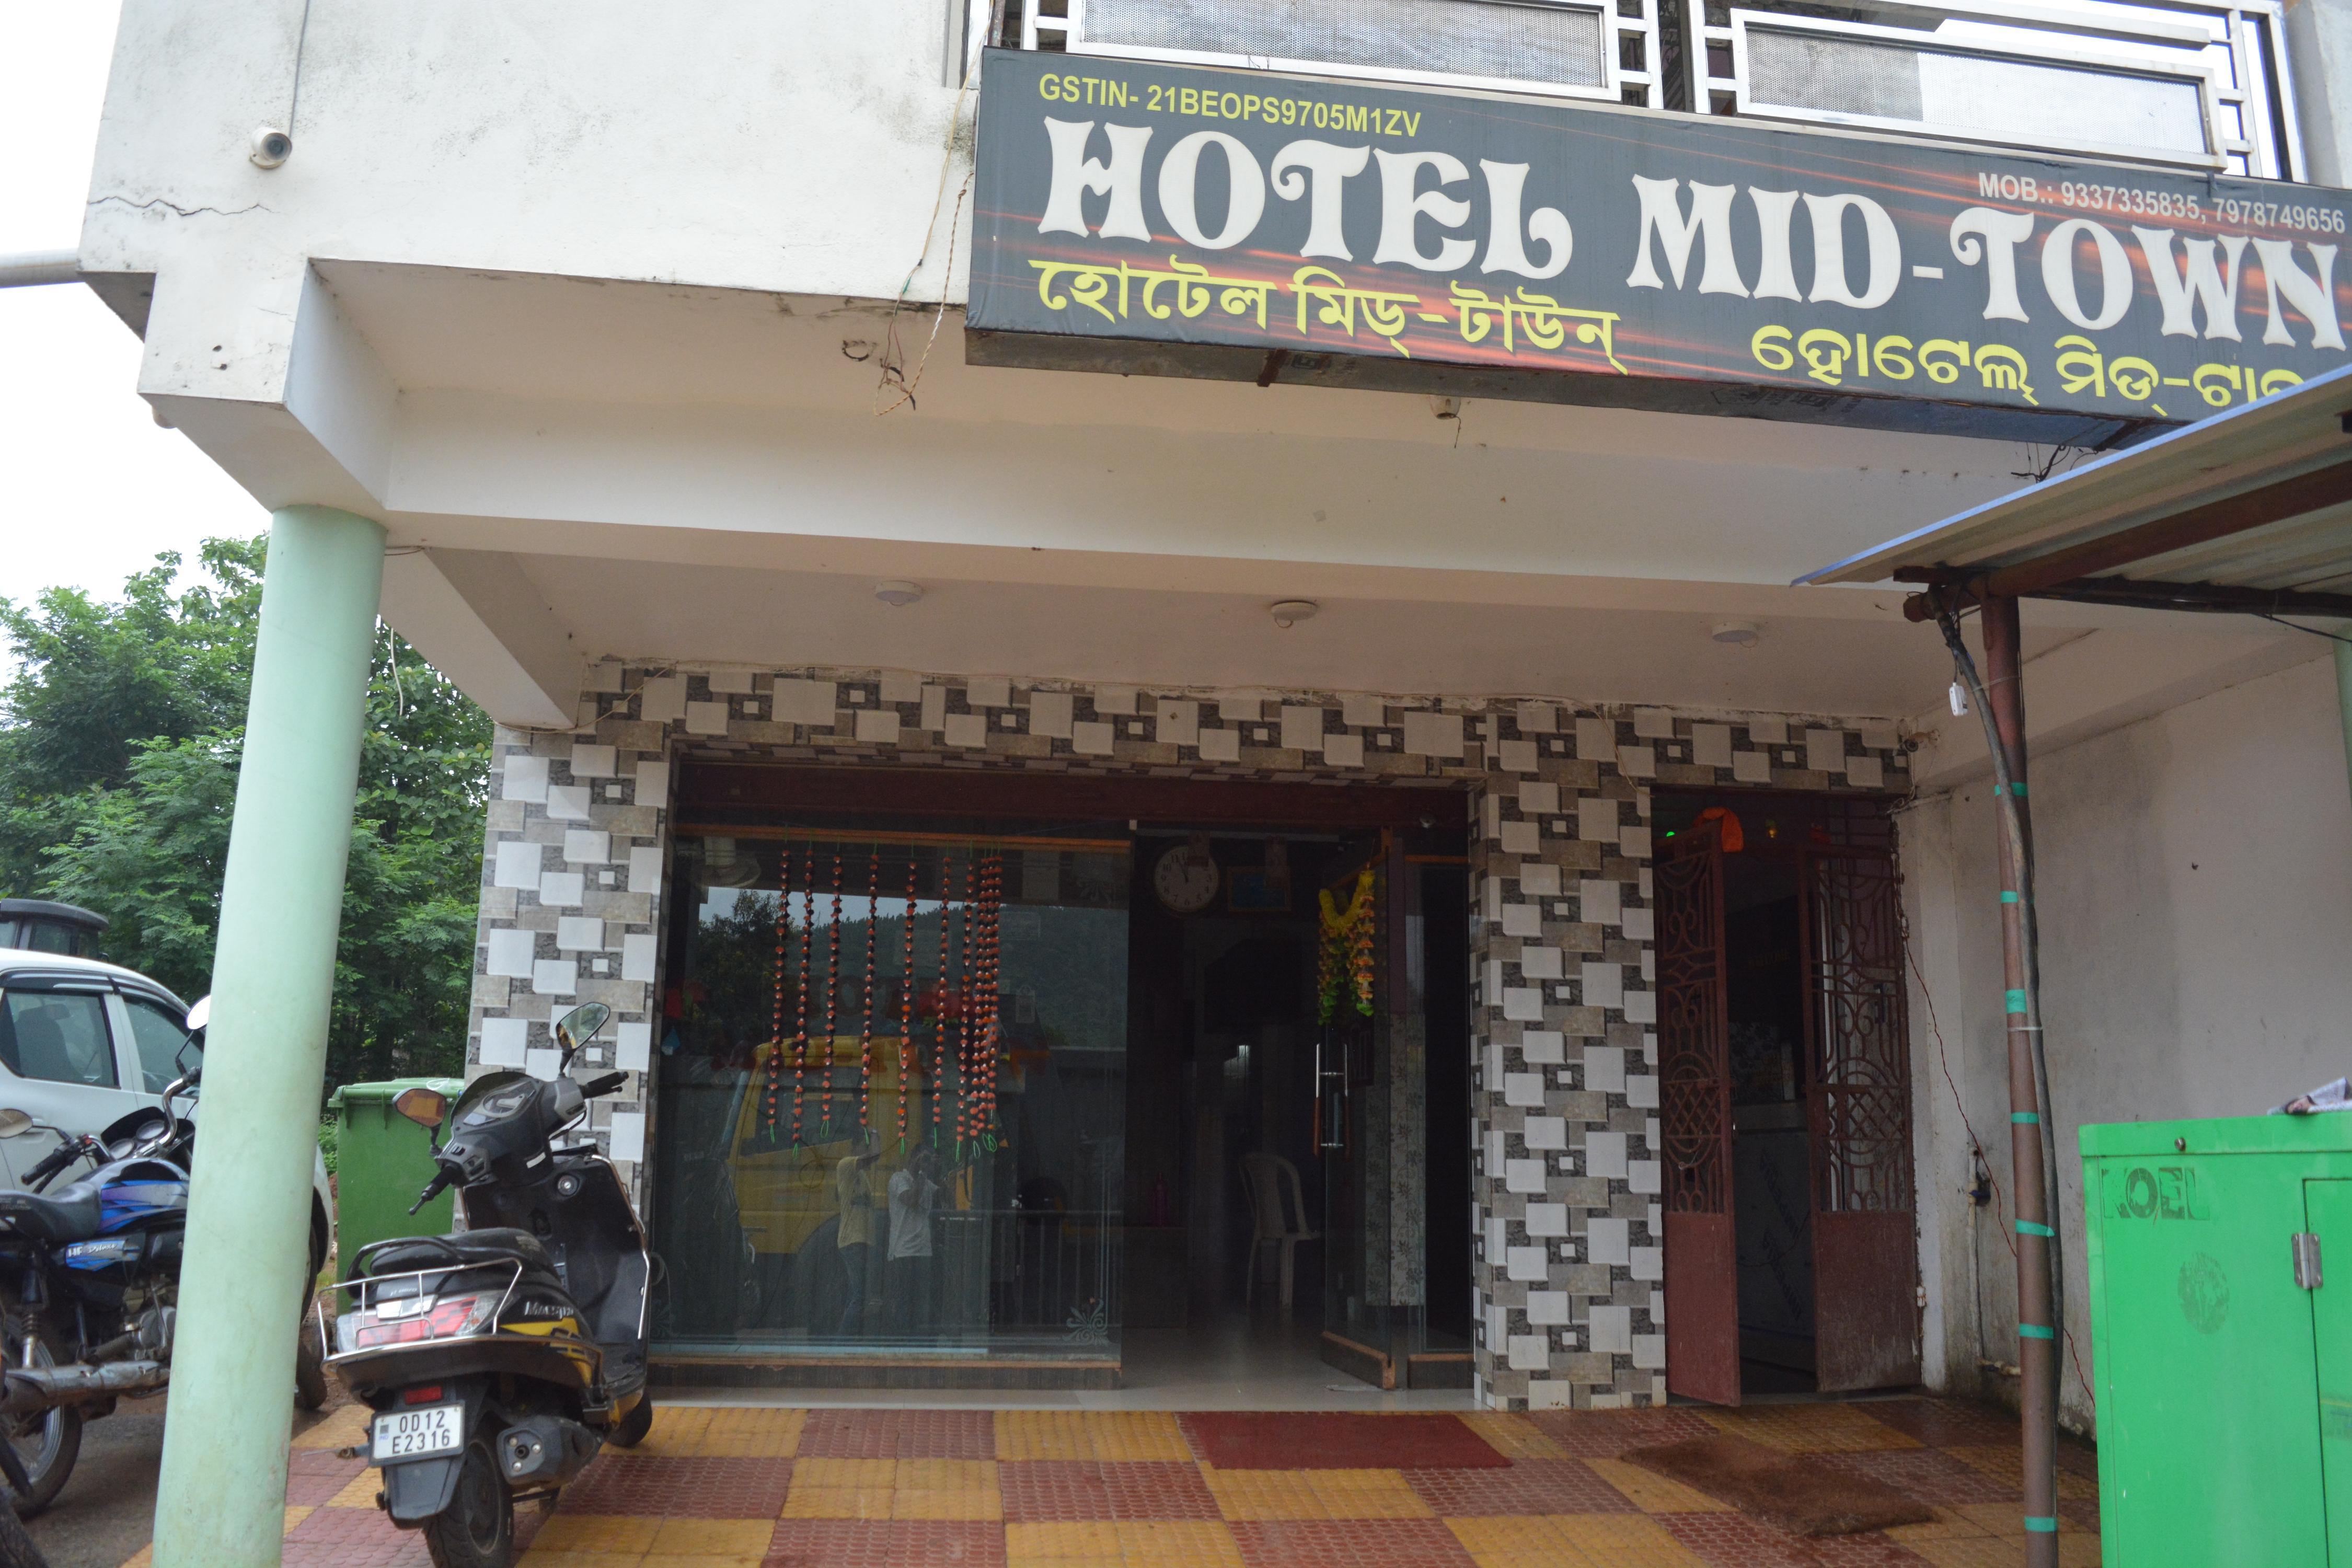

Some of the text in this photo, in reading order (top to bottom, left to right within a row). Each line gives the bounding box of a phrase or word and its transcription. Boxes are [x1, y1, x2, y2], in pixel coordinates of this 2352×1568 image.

[1040, 73, 1421, 137] GSTIN- 21BEOPS9705M1ZV
[1037, 116, 2346, 352] HOTEL MID-TOWN
[1979, 172, 2346, 234] MOB.: 9337335835, 7978749656
[1028, 254, 1278, 329] হোটেল
[392, 1428, 451, 1455] E2316
[399, 1410, 445, 1433] OD12
